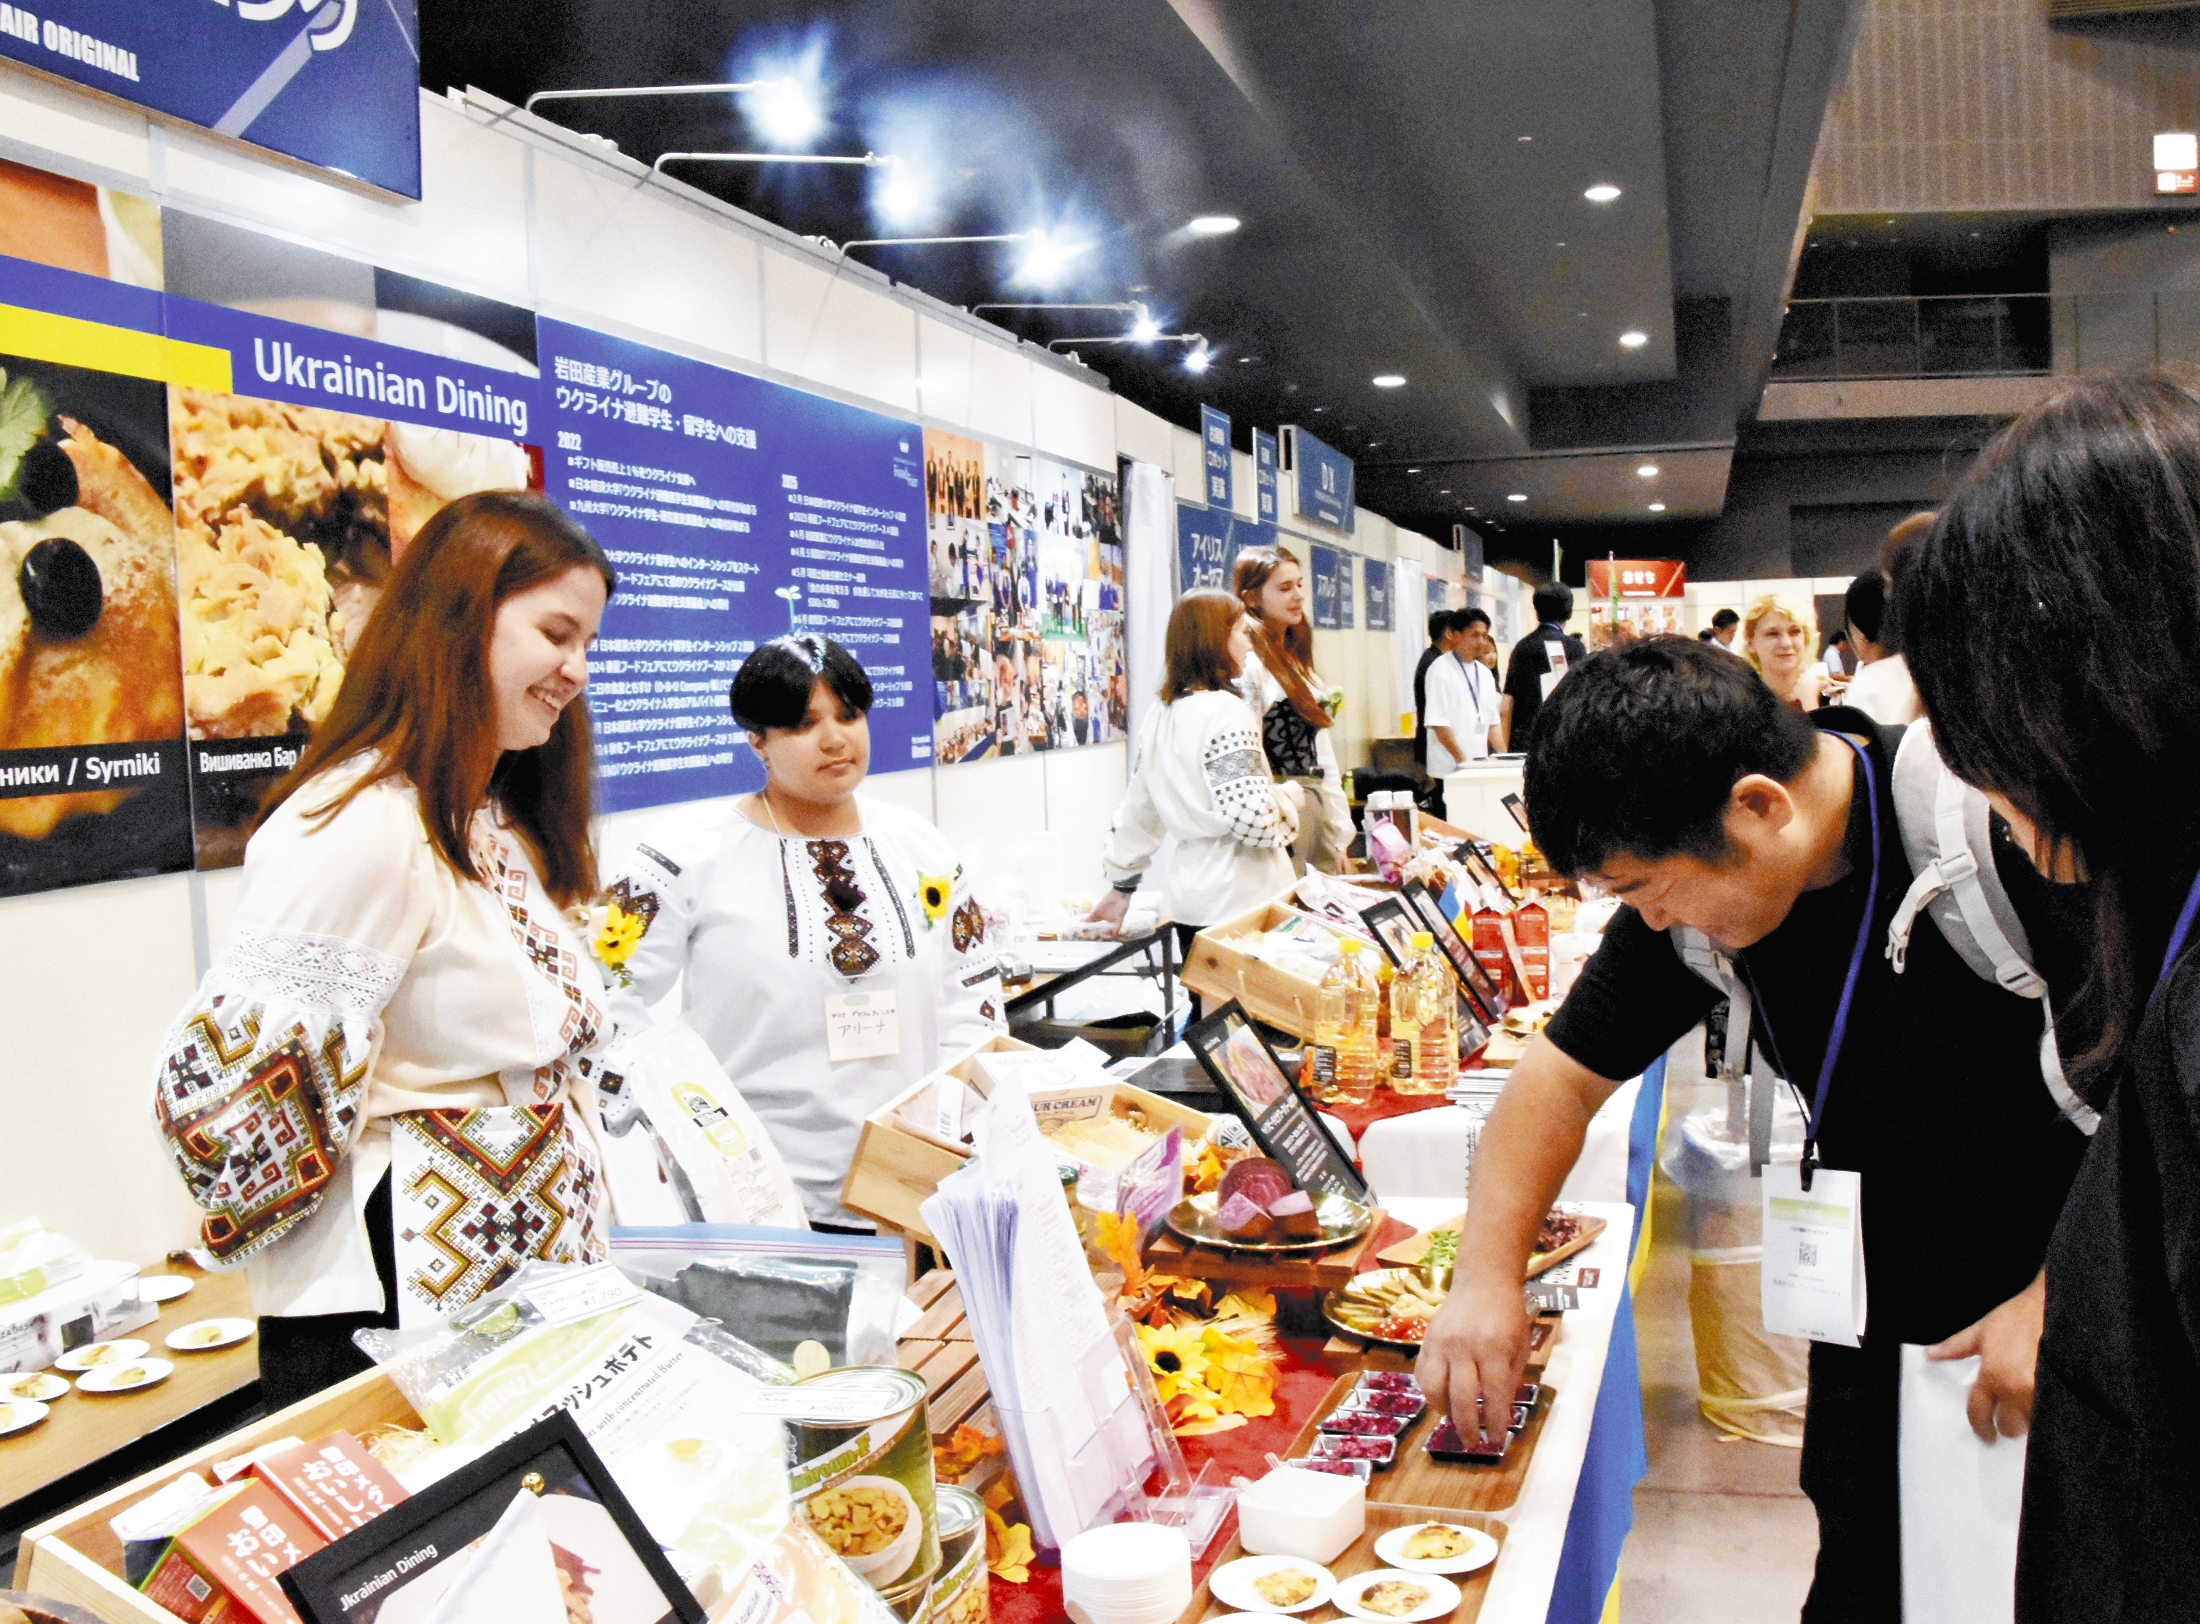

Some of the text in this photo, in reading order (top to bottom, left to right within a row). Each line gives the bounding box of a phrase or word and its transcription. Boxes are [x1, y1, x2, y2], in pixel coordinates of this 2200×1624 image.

[43, 20, 140, 82] ORIGINAL
[254, 338, 528, 437] Ukrainian Dining
[554, 355, 672, 404] 岩田産業グループの
[1191, 532, 1224, 563] アイリス
[0, 764, 60, 787] ники
[85, 752, 161, 784] Syrniki
[199, 751, 272, 773] Вишиванка
[273, 746, 297, 770] Бар
[836, 1019, 886, 1038] アリーナ
[1052, 1096, 1098, 1112] CREAM
[596, 1412, 616, 1431] with
[615, 1370, 662, 1415] concentrated
[657, 1351, 684, 1374] Butter
[395, 1543, 439, 1575] Dining
